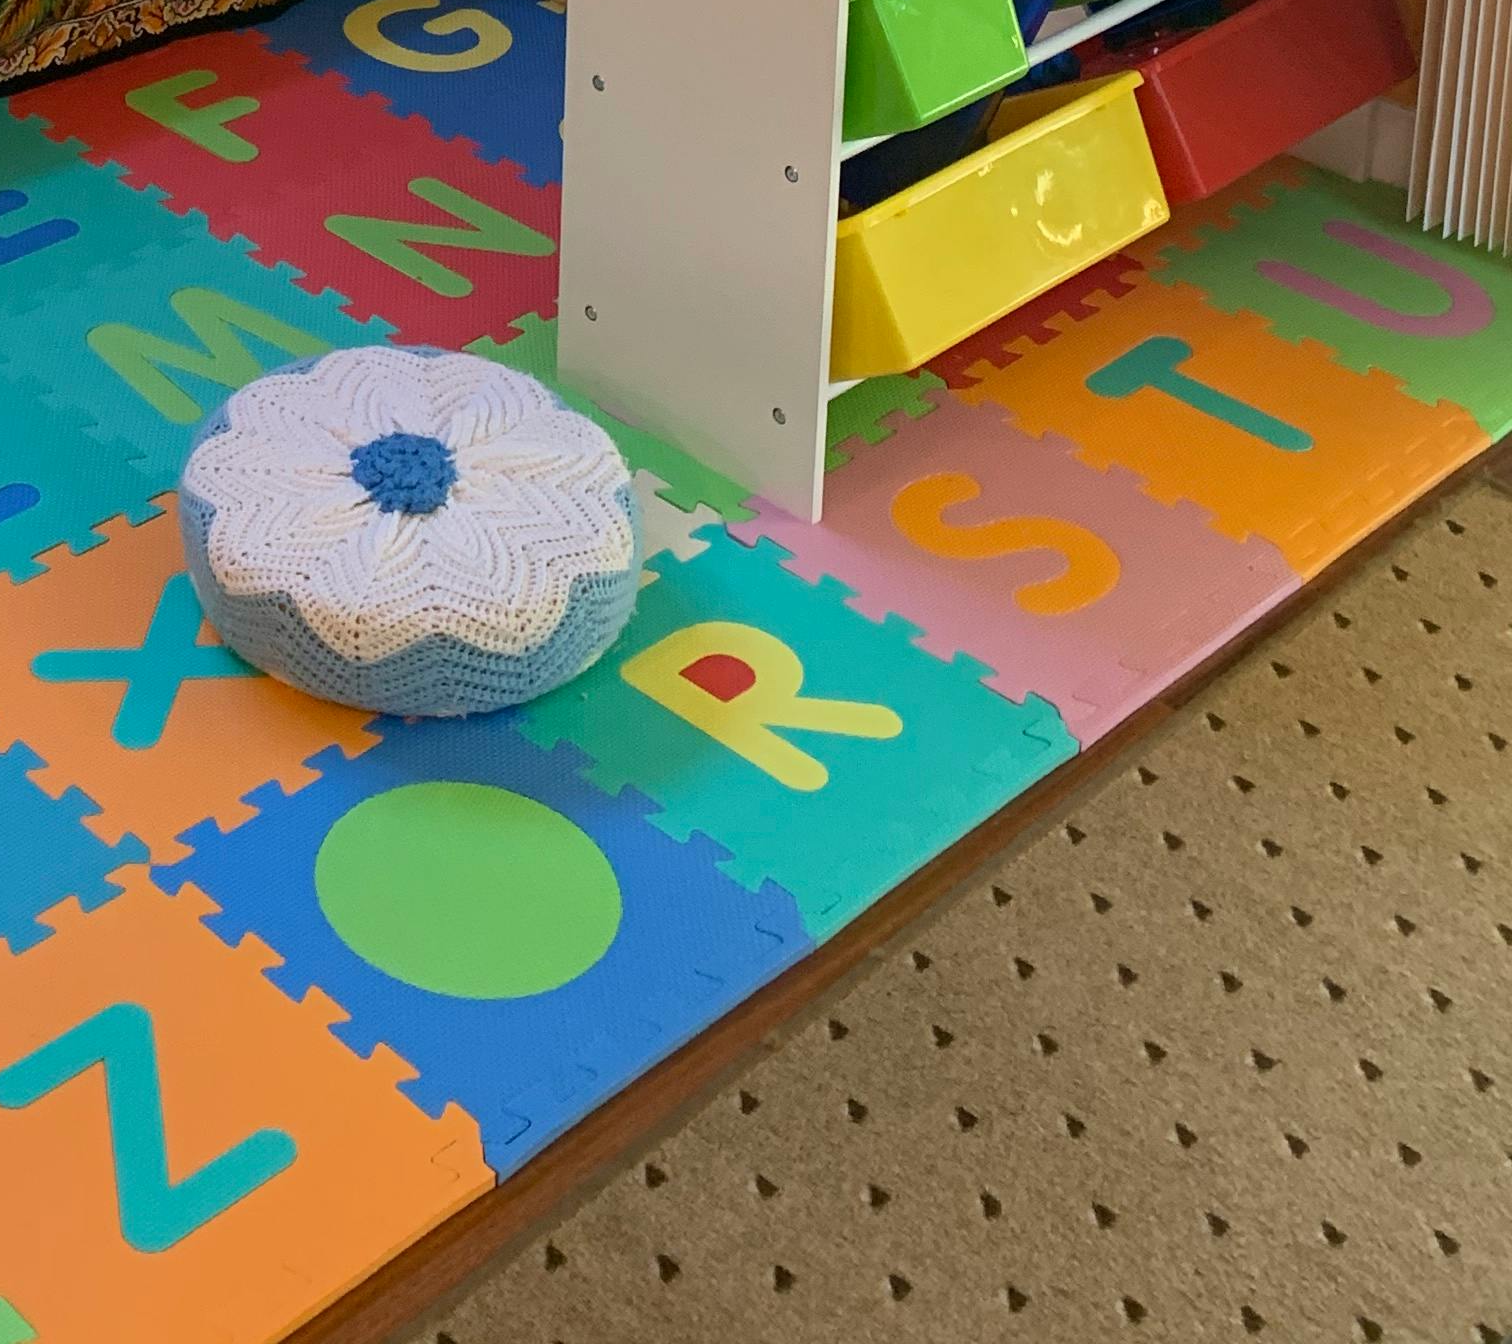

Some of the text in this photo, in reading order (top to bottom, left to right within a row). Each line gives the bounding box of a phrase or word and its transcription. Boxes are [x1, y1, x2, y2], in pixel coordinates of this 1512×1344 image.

[125, 70, 260, 163] F
[88, 287, 339, 424] M
[325, 177, 556, 298] N
[620, 220, 1494, 792] R S T U
[31, 574, 273, 750] X
